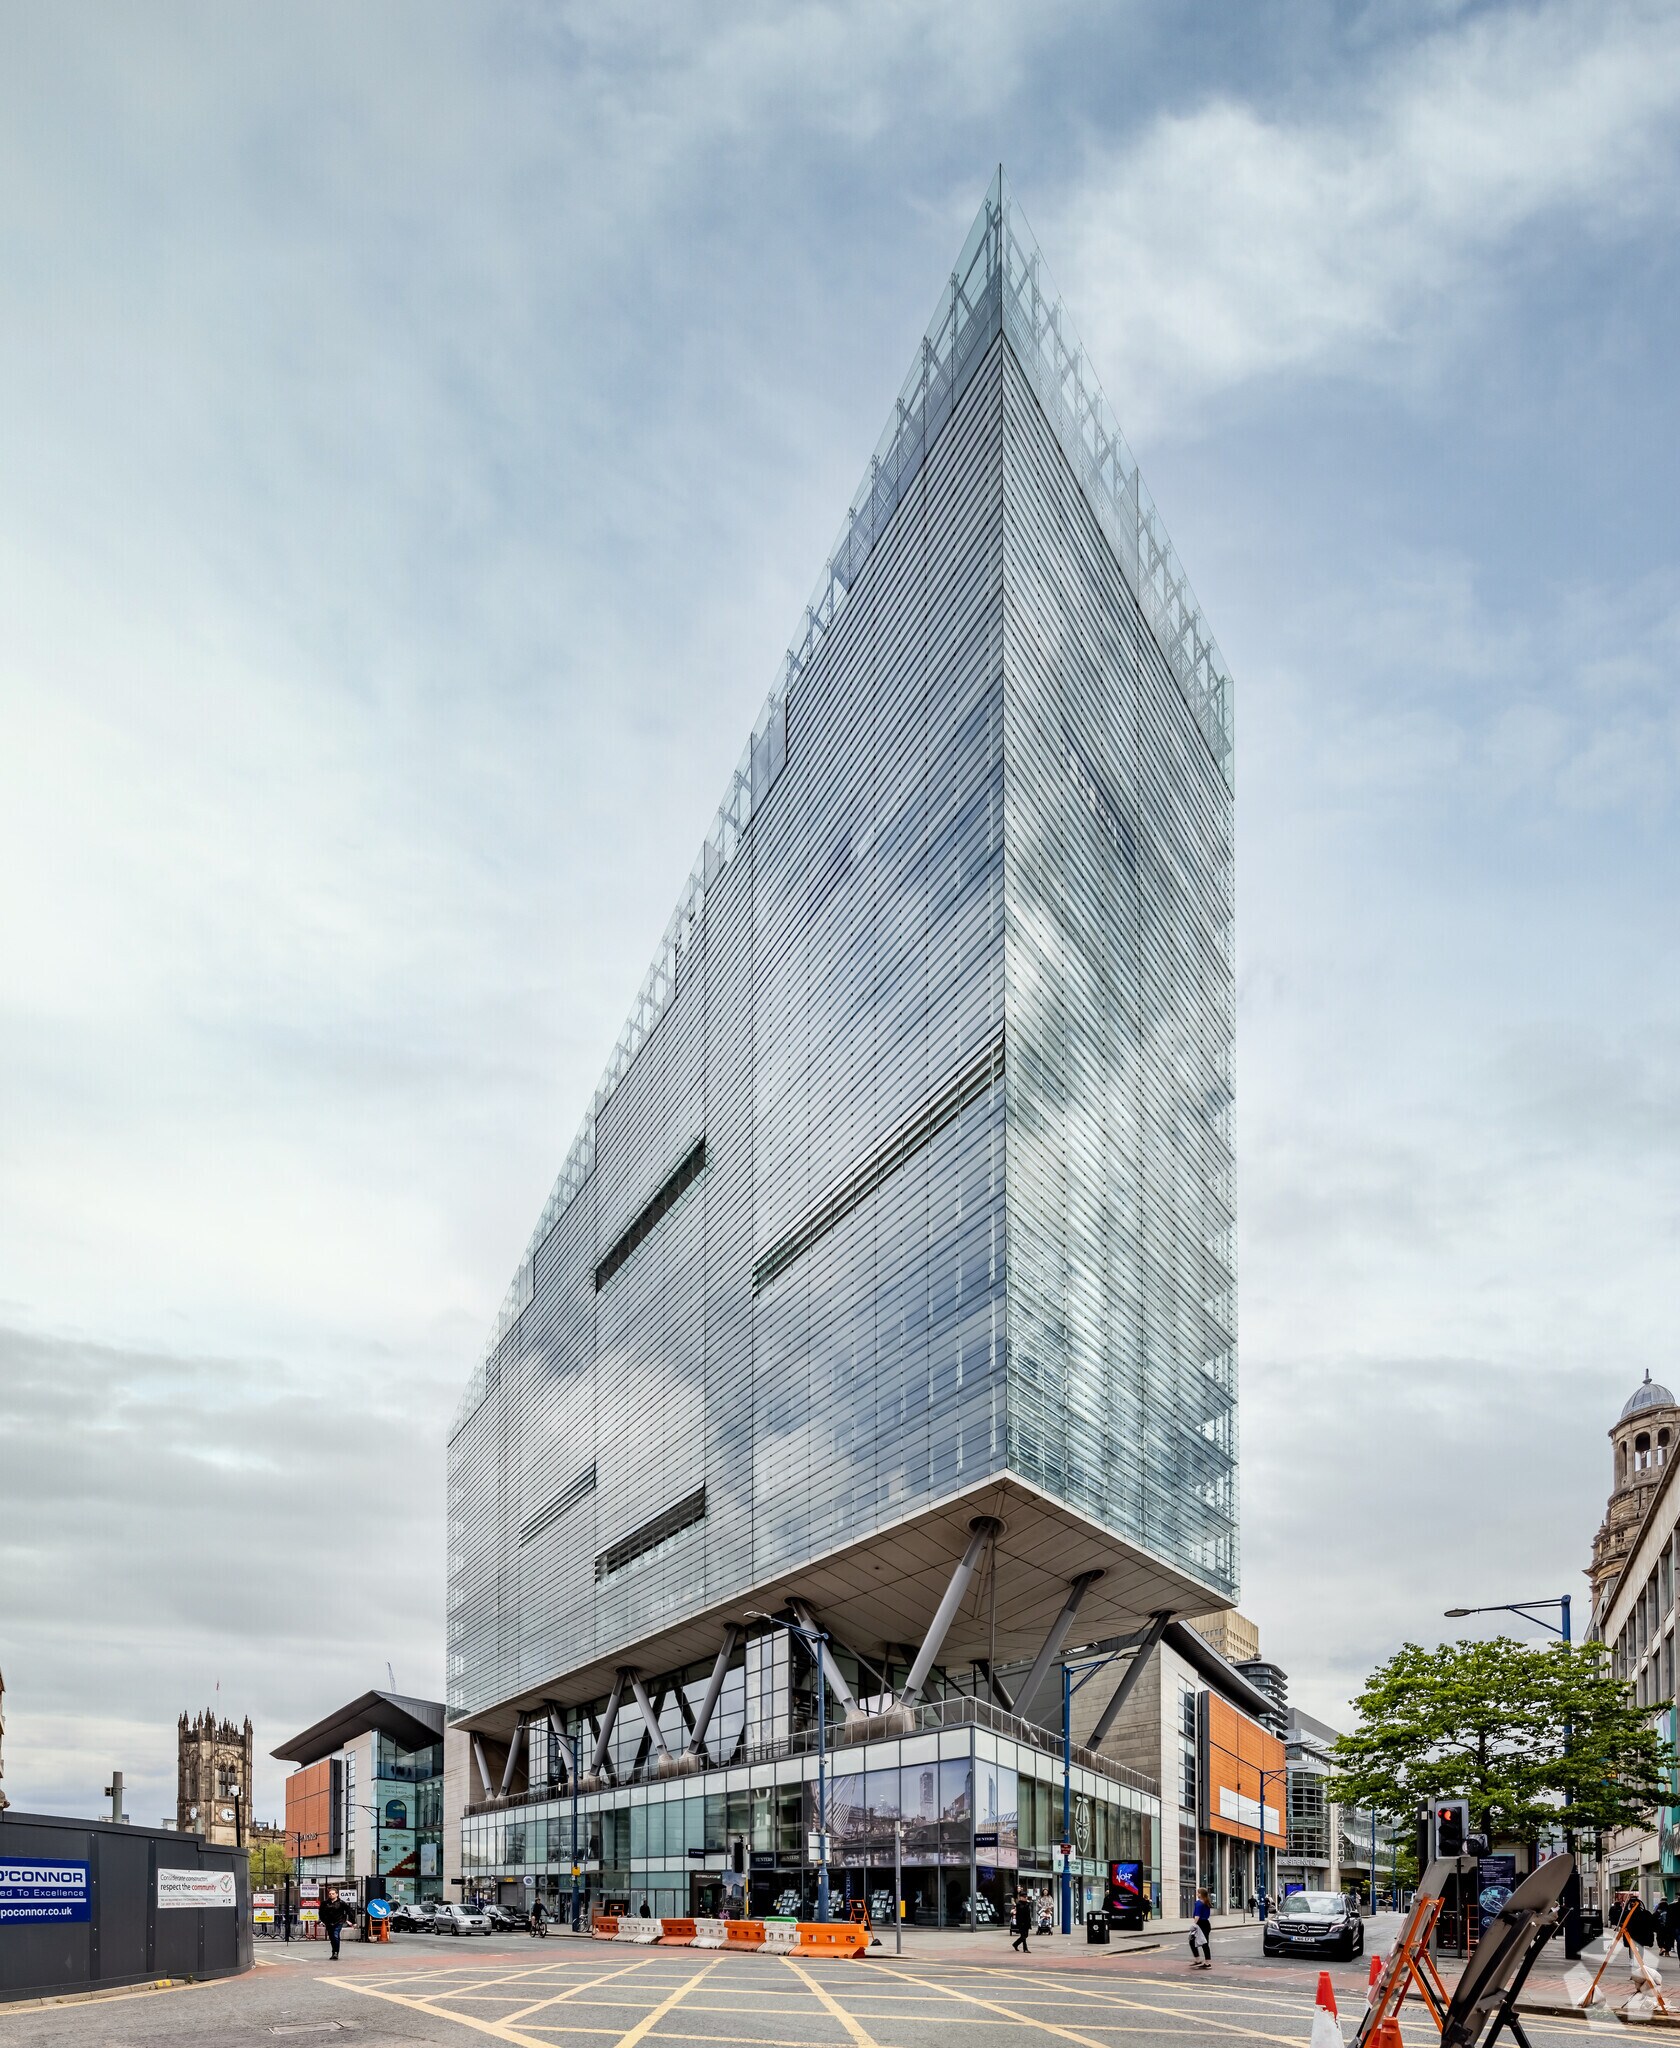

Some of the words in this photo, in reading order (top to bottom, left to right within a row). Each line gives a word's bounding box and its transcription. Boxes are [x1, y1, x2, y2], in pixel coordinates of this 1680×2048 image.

[1337, 1815, 1345, 1863] SPENCER
[160, 1884, 181, 1892] respect
[191, 1884, 217, 1892] community
[0, 1906, 72, 1919] poconnor.co.uk
